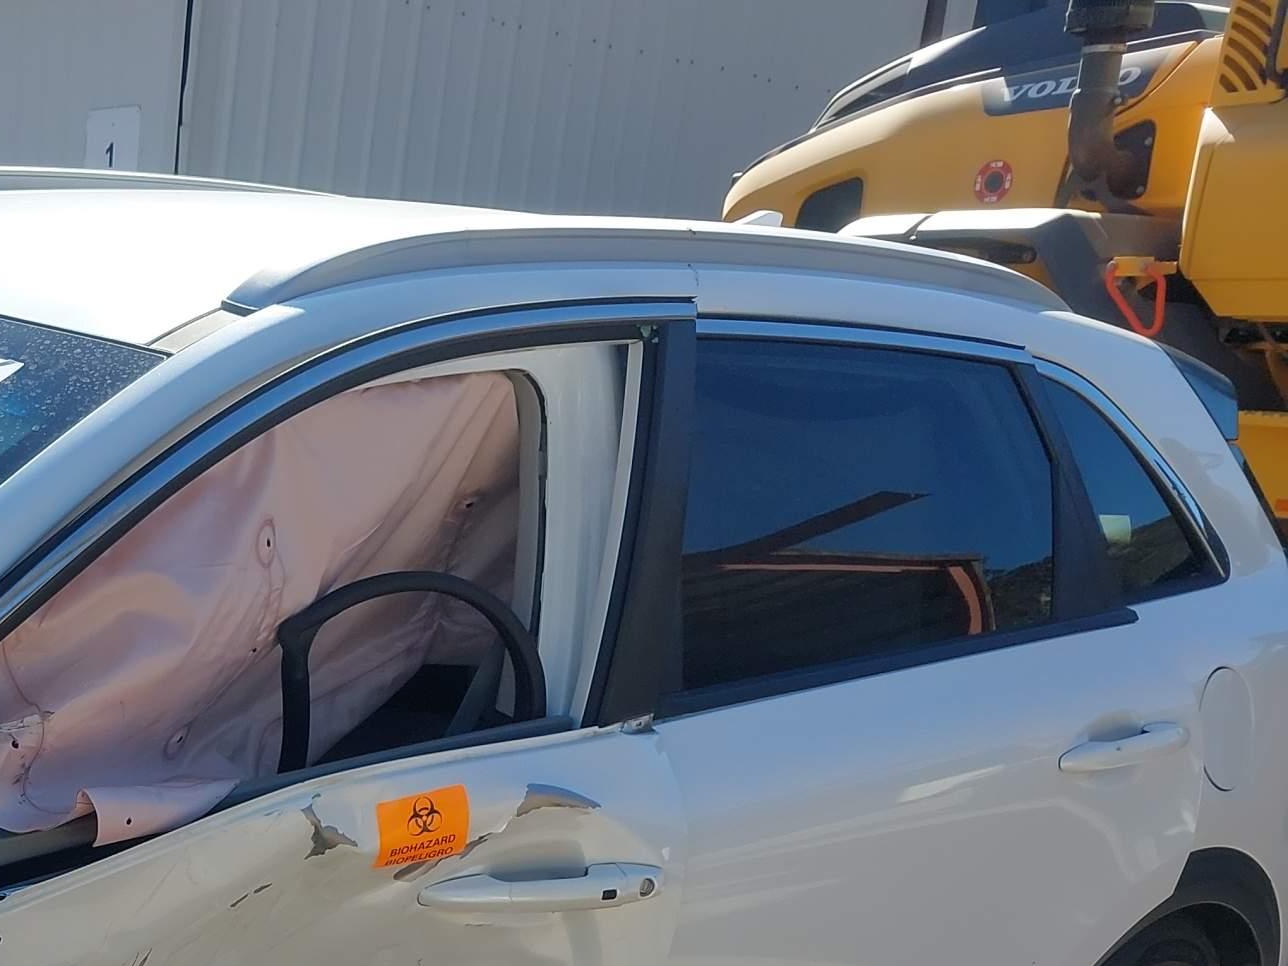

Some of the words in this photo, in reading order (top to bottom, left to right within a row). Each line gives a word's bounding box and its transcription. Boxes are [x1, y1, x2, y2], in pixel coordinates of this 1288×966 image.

[1001, 66, 1142, 102] VOLO
[105, 142, 114, 168] 1
[385, 846, 454, 866] BIOPELIGRO
[389, 834, 456, 857] BIOHAZARD
